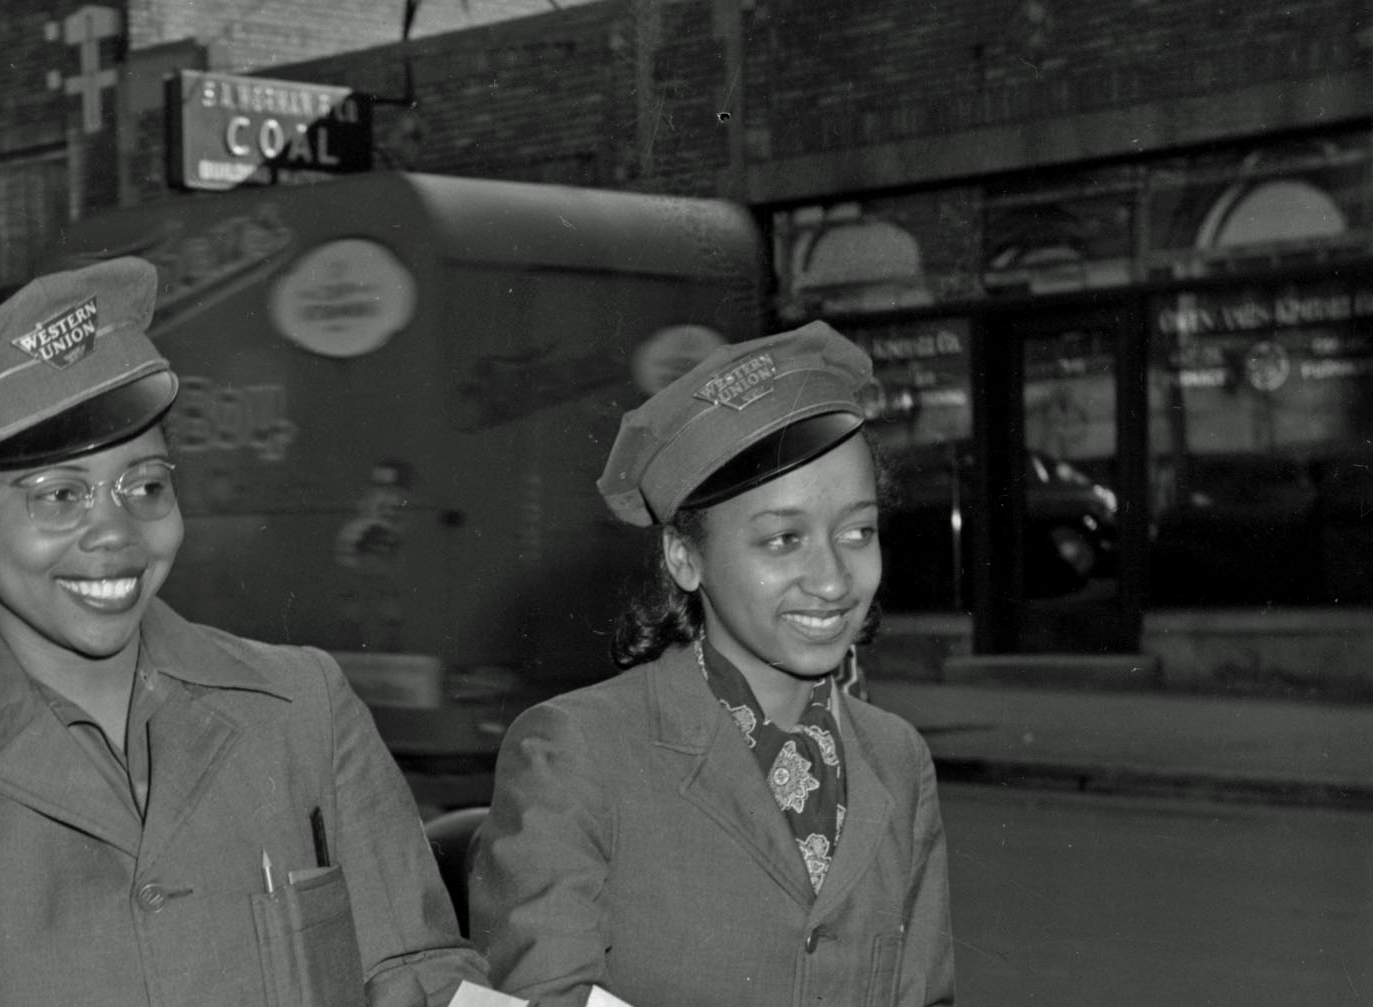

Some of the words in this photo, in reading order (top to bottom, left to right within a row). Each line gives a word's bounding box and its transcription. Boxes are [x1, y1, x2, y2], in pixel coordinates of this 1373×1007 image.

[227, 116, 339, 164] COAL
[20, 300, 96, 350] WESTERN
[40, 320, 95, 360] UNION
[700, 354, 773, 397] WESTERN
[719, 367, 772, 402] UNION
